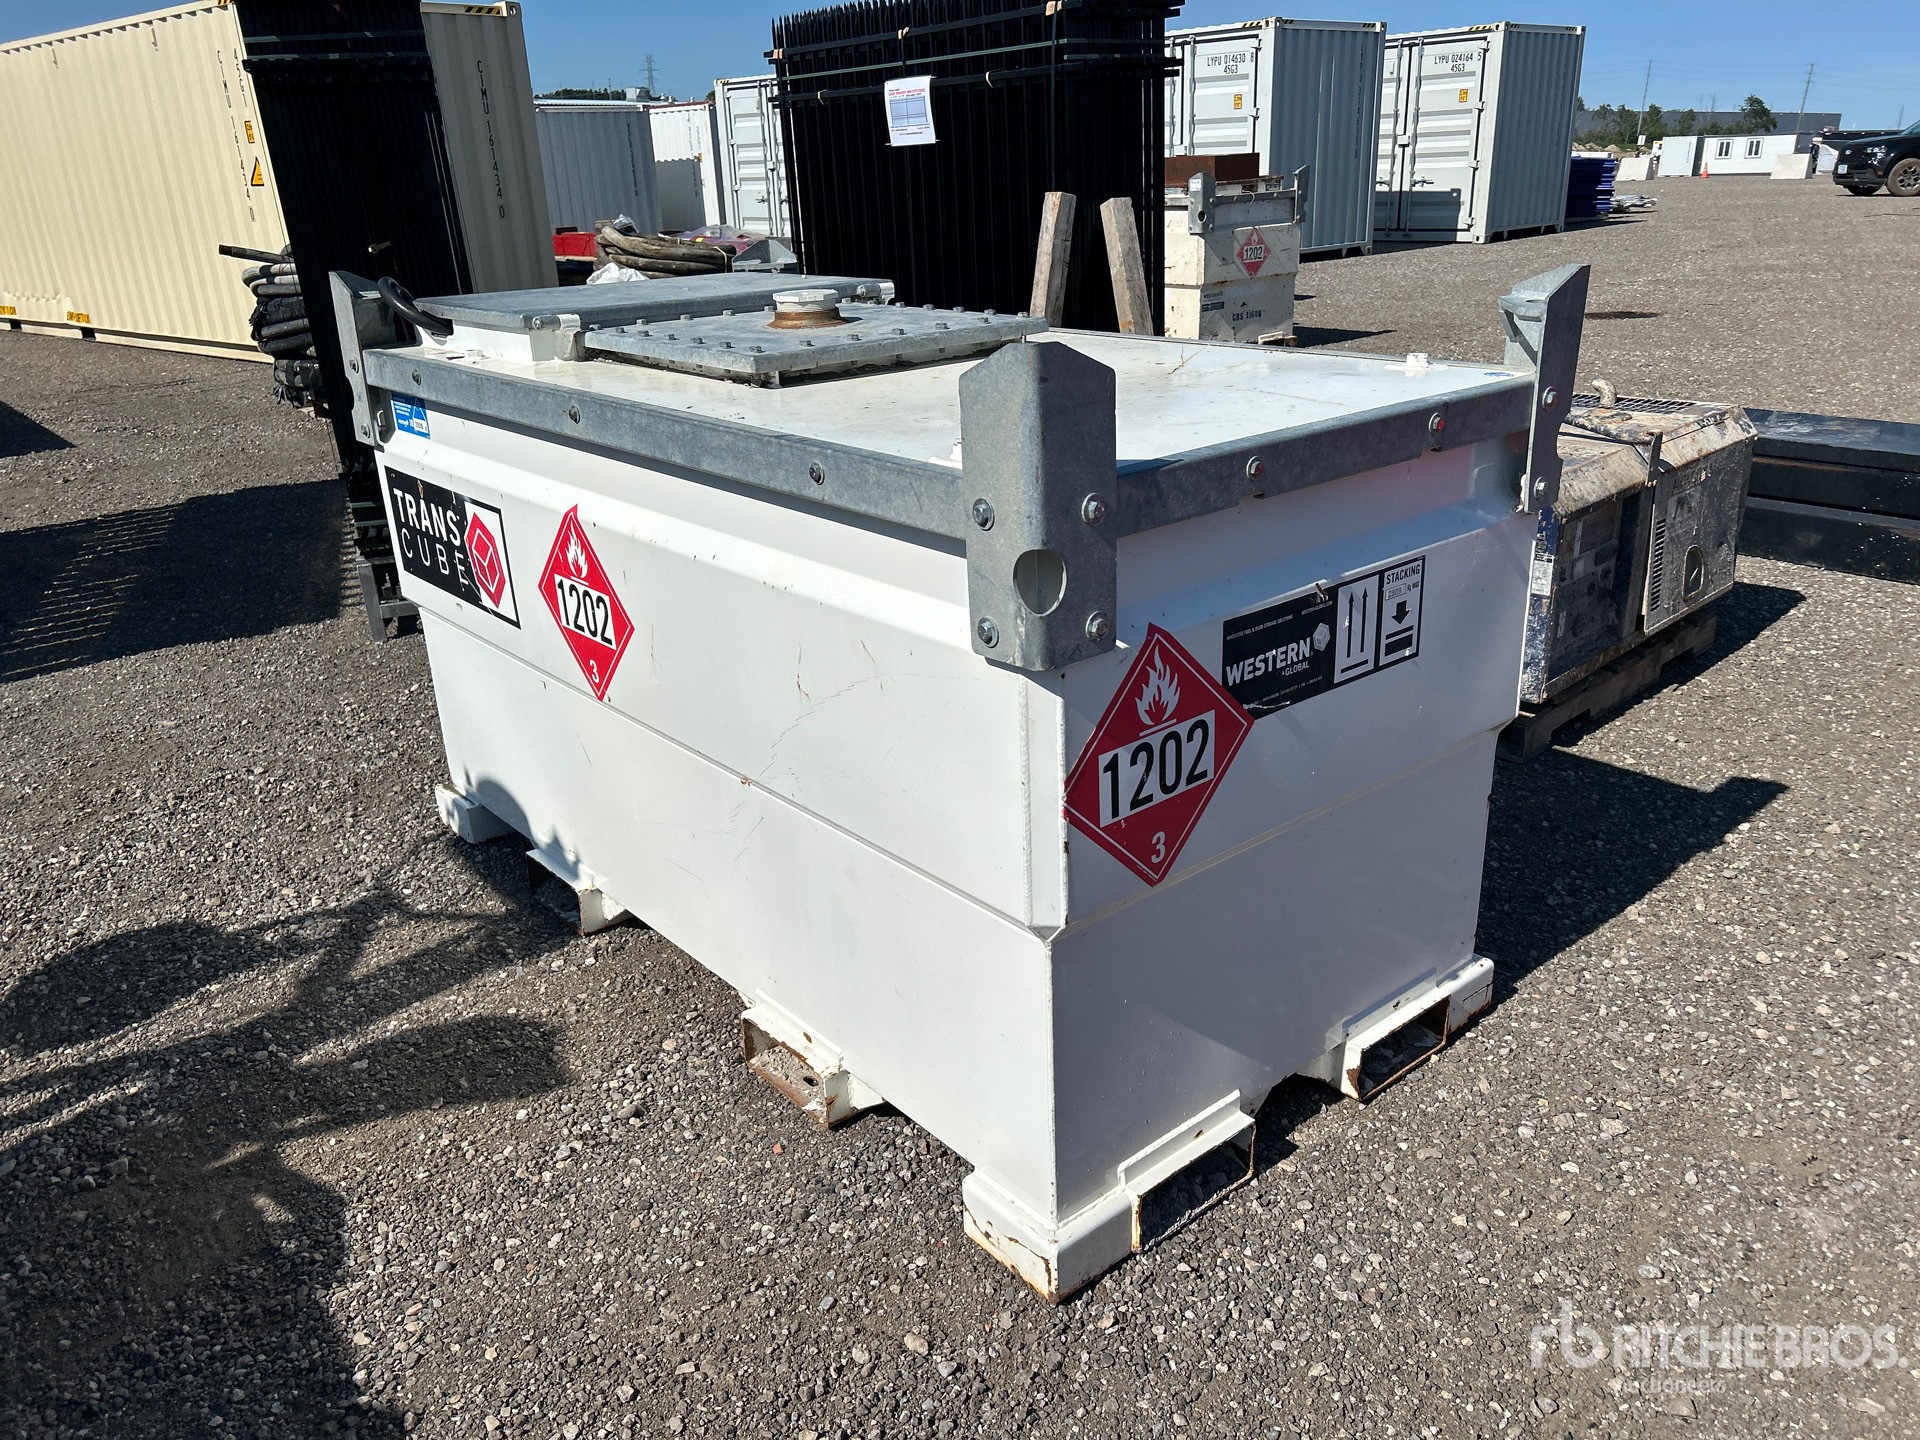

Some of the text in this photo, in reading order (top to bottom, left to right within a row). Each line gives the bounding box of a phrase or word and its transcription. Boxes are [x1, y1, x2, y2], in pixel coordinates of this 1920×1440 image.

[1207, 56, 1222, 66] LYPU
[1224, 53, 1246, 64] 014630
[1223, 64, 1238, 74] 45G3
[1434, 52, 1482, 64] LYPU 024164 5
[1451, 63, 1465, 72] 45G3
[233, 48, 247, 108] 45G1
[217, 50, 231, 108] CIMU
[231, 116, 251, 201] 161434
[477, 60, 505, 218] CIMU 161434 0
[1244, 246, 1263, 260] 1202
[393, 488, 461, 546] TRANS
[401, 528, 469, 585] CUBE
[1386, 564, 1421, 585] STACKING
[557, 579, 613, 646] 1202
[590, 659, 600, 683] 3
[1225, 637, 1311, 687] WESTERN
[1285, 661, 1310, 676] GLOBAL
[1103, 718, 1210, 820] 1202
[1151, 830, 1166, 864] 3
